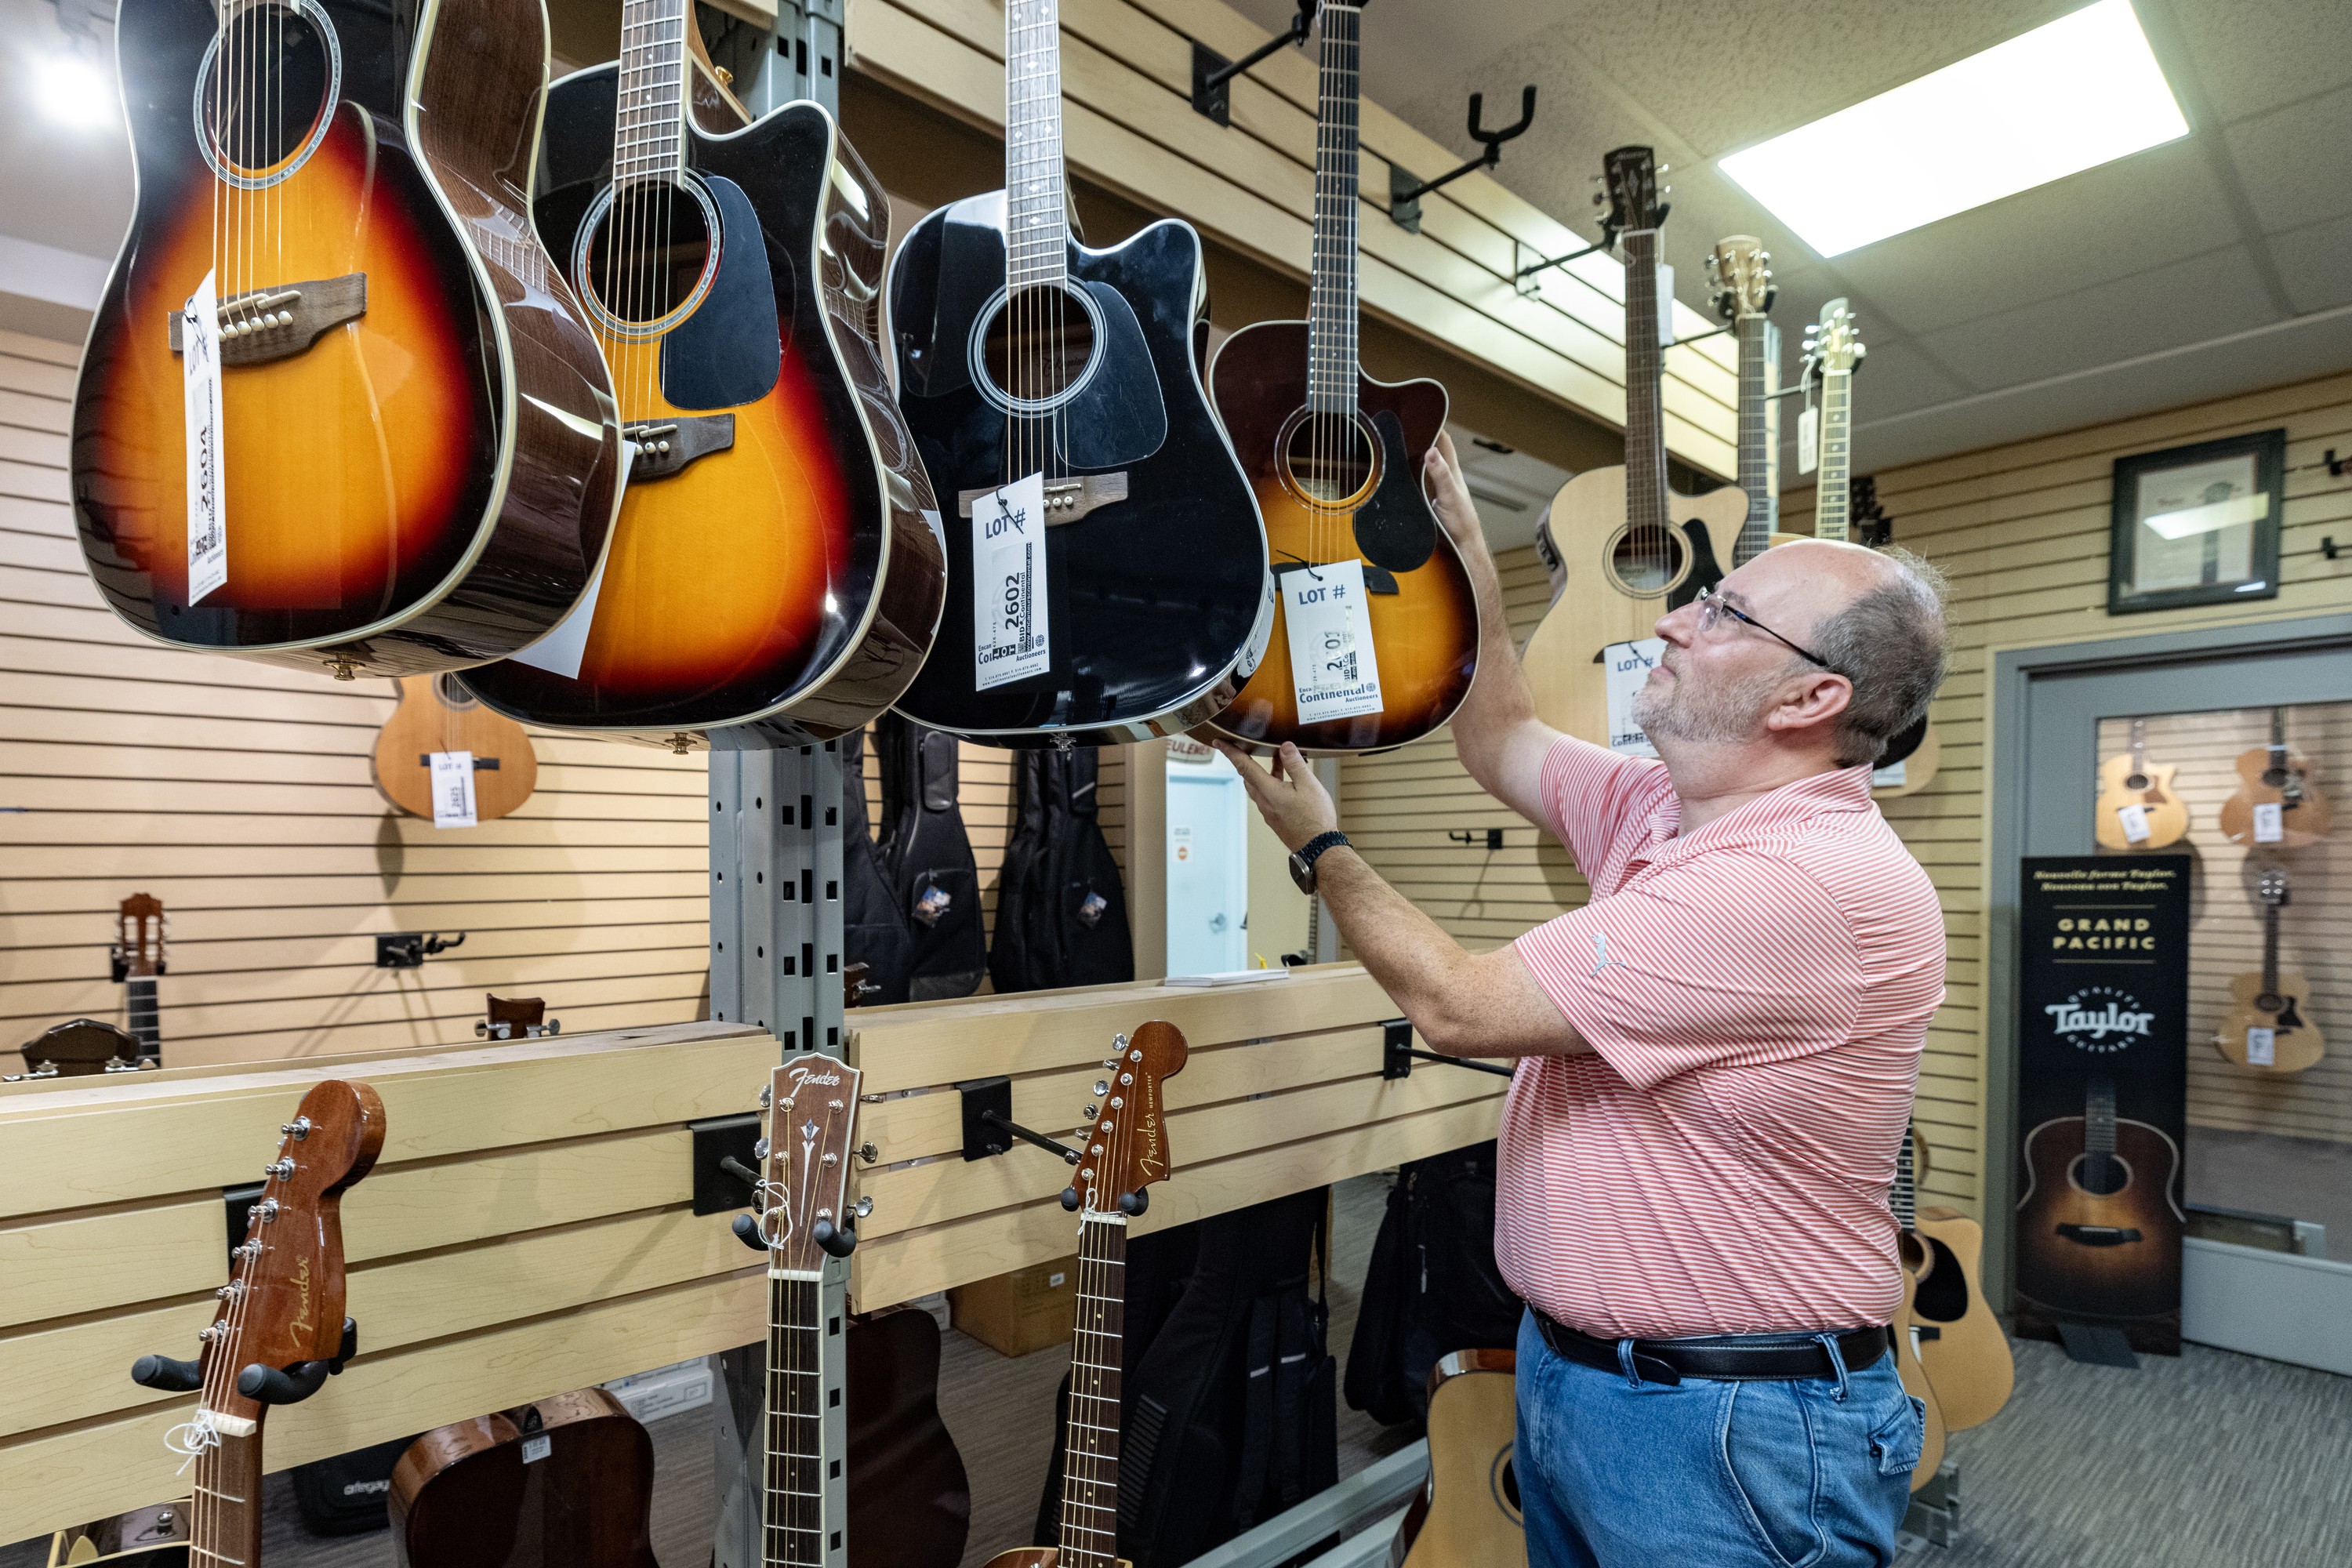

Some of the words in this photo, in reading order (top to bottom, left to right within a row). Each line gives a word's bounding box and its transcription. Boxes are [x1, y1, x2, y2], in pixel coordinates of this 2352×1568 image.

[200, 425, 209, 513] 2604
[985, 514, 1010, 539] LOT
[1014, 507, 1026, 528] #
[1005, 572, 1020, 630] 2602
[1298, 587, 1326, 605] LOT
[1333, 584, 1345, 600] #
[978, 643, 992, 652] Encan
[1016, 649, 1046, 662] Auctioneers
[1323, 630, 1343, 672] 201
[1617, 659, 1639, 672] LOT
[1299, 684, 1366, 704] Continental
[1345, 693, 1378, 702] Auctioneers
[2057, 918, 2150, 931] GRAND
[2052, 936, 2156, 950] PACIFIC
[2044, 1002, 2156, 1039] Taylor
[789, 1067, 840, 1098] Fender
[1136, 1112, 1164, 1177] Fender
[289, 1257, 314, 1348] Fender
